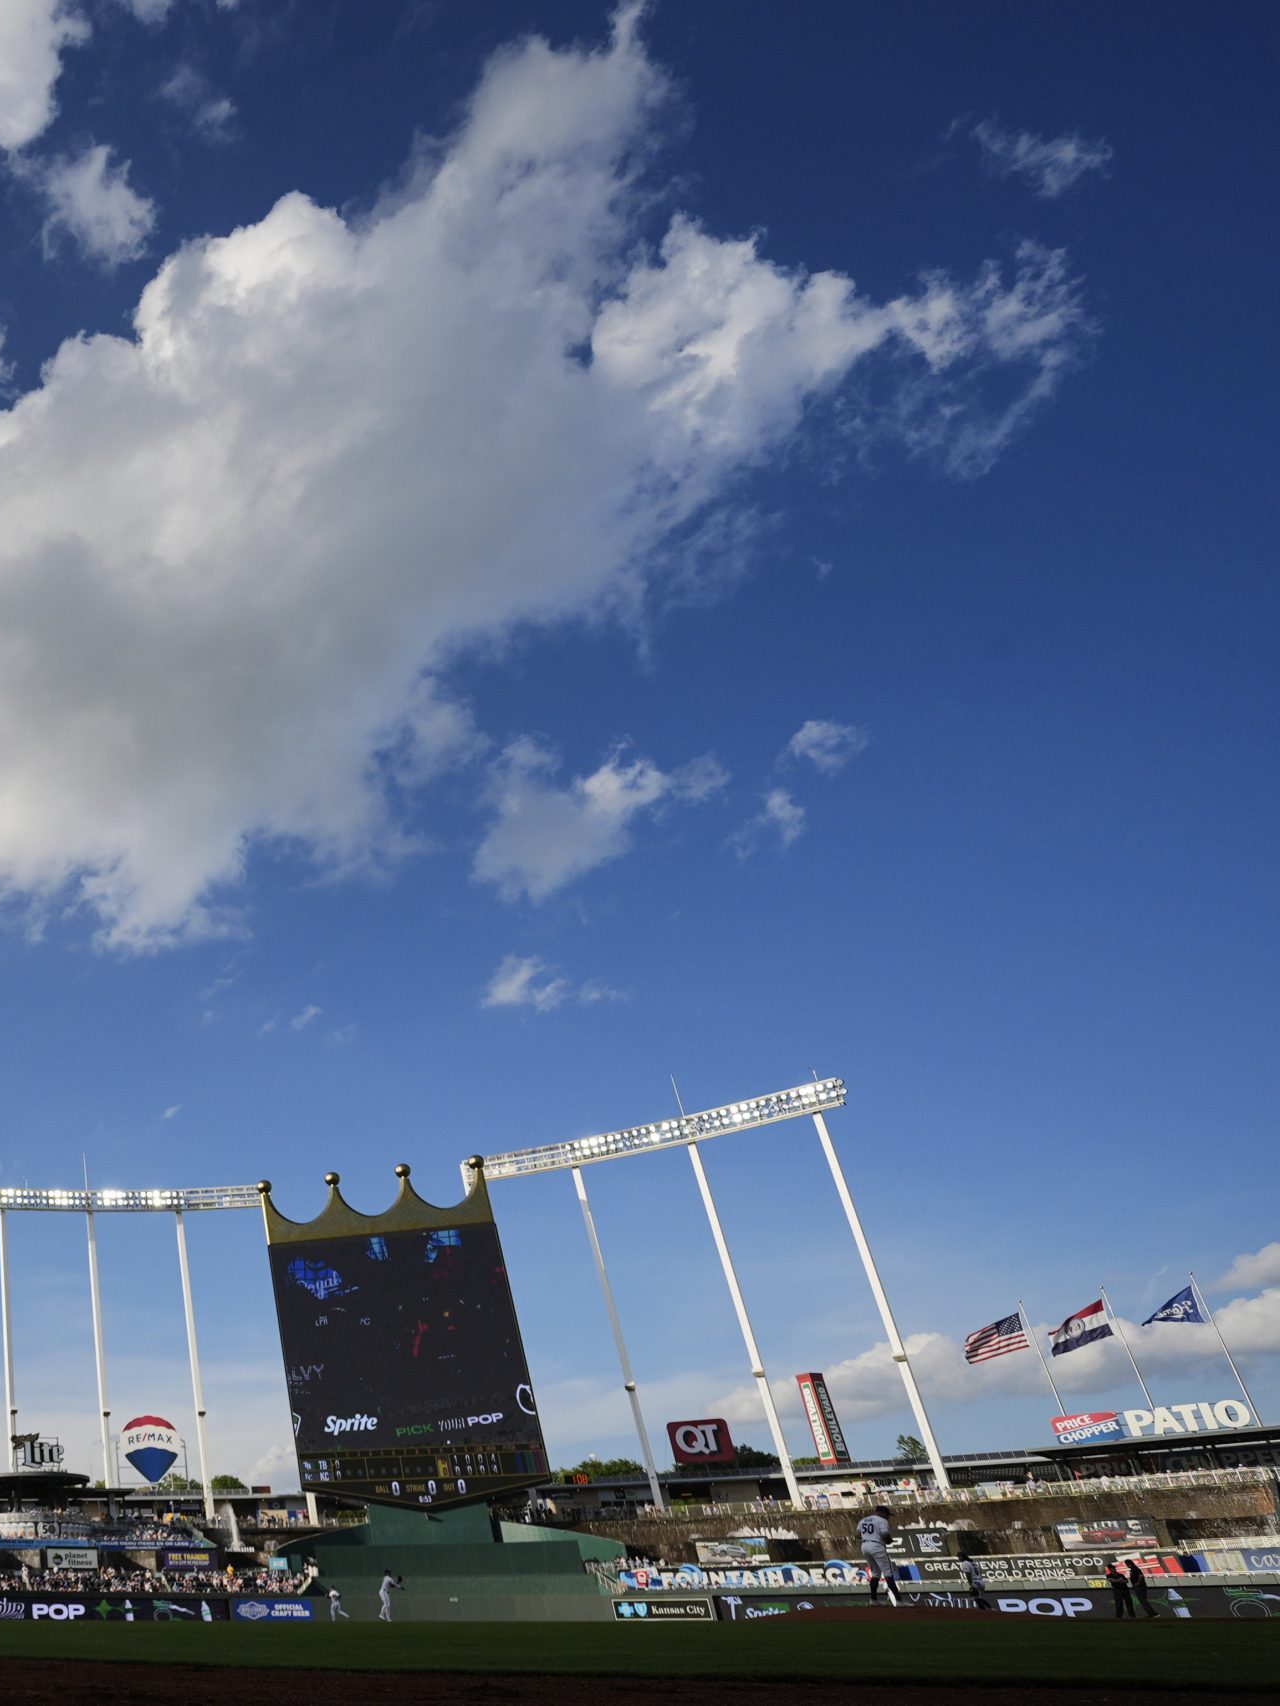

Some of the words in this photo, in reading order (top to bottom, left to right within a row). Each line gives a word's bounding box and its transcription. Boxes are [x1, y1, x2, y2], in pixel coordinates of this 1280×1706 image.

[324, 1413, 378, 1436] Sprite
[395, 1423, 434, 1437] PICK
[466, 1412, 504, 1427] POP
[803, 1387, 828, 1454] BOULEVARD
[819, 1386, 845, 1451] BOULEVARD
[1055, 1414, 1094, 1432] PRICE
[1123, 1400, 1251, 1437] PATIO
[128, 1433, 173, 1445] RE/MAX
[675, 1423, 719, 1455] QT
[1059, 1421, 1120, 1444] CHOPPER
[22, 1440, 64, 1468] Lite
[318, 1460, 328, 1471] TB
[320, 1472, 330, 1482] KC
[375, 1485, 390, 1494] BALL
[391, 1481, 400, 1497] 0
[405, 1483, 427, 1493] STRIKE
[427, 1480, 437, 1495] 0
[443, 1483, 455, 1492] OUT
[457, 1479, 466, 1494] 0
[862, 1524, 874, 1534] 50
[925, 1561, 964, 1572] GREAT
[1019, 1559, 1061, 1569] FRESH
[1065, 1557, 1103, 1568] FOOD
[1024, 1568, 1075, 1578] DRINKS
[661, 1570, 784, 1588] FOUNTAIN
[793, 1567, 858, 1587] DECK
[1089, 1580, 1108, 1589] 387
[32, 1603, 85, 1620] POP
[651, 1605, 685, 1615] Kansas
[687, 1605, 705, 1616] City
[998, 1598, 1092, 1617] POP
